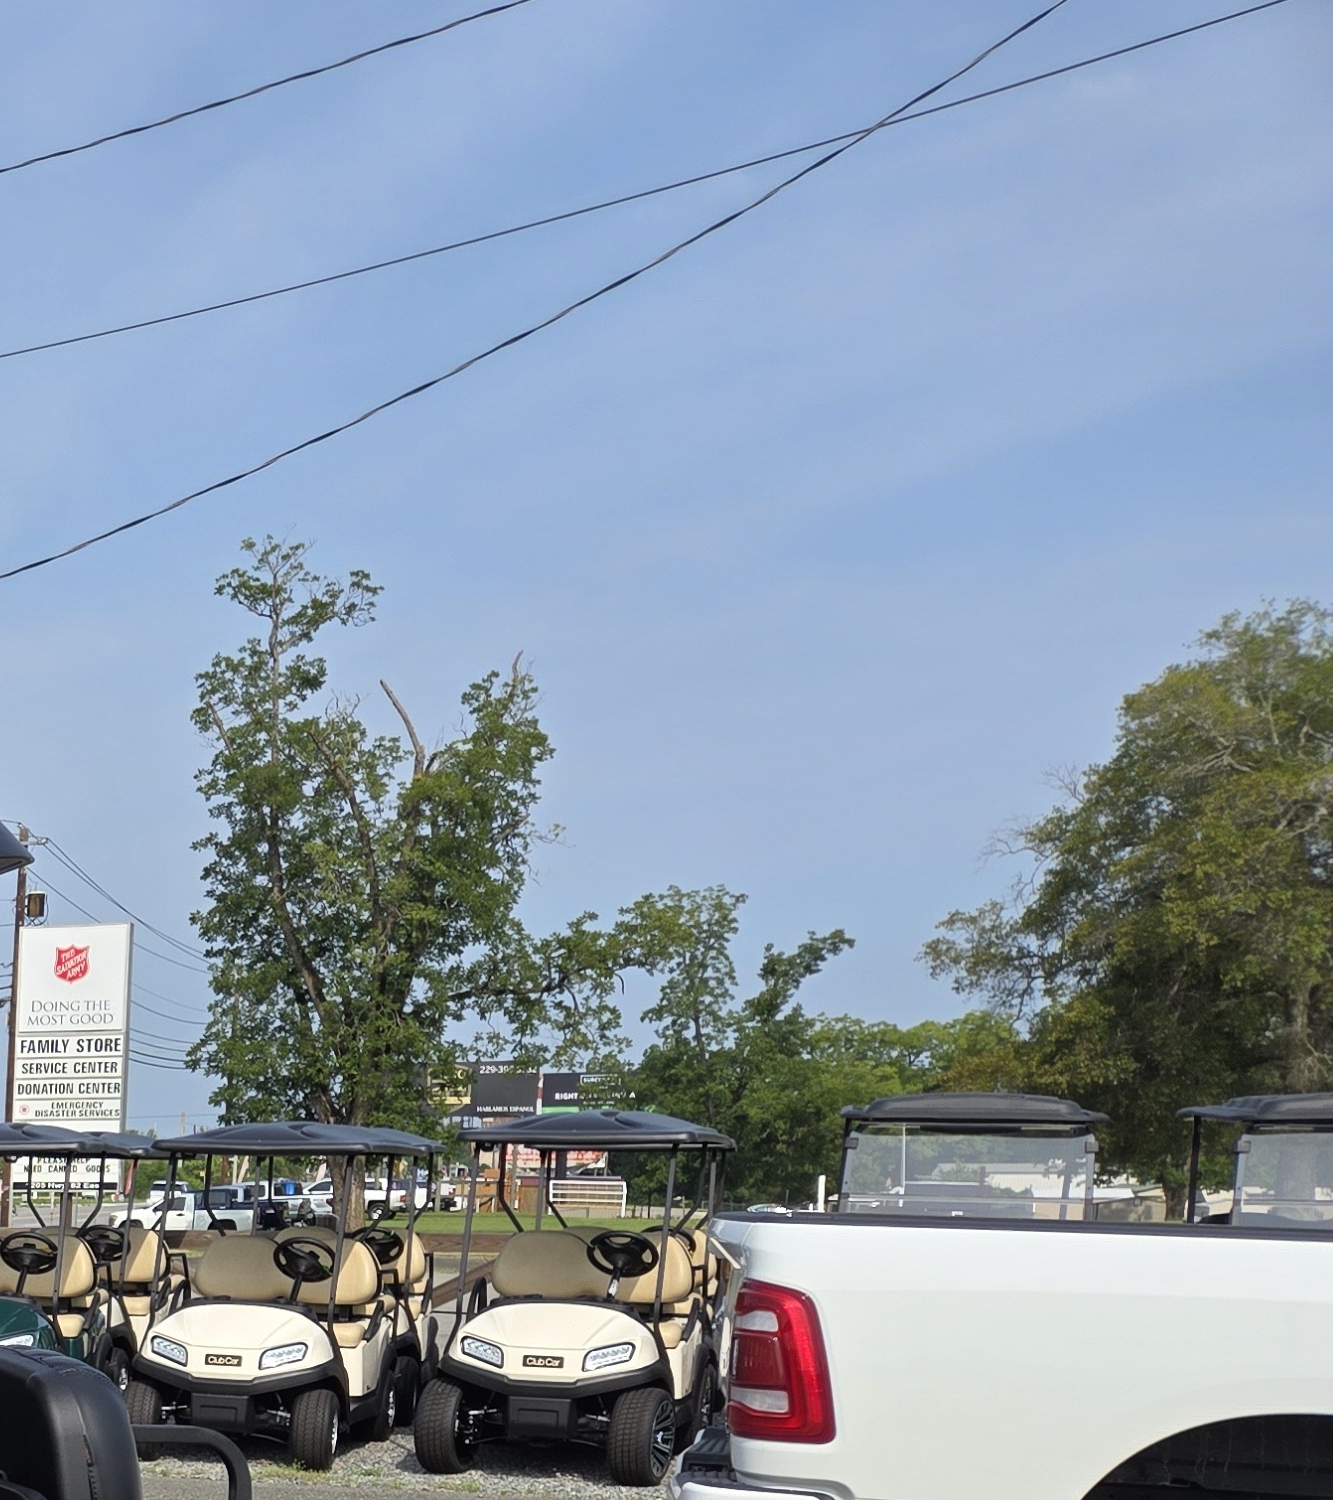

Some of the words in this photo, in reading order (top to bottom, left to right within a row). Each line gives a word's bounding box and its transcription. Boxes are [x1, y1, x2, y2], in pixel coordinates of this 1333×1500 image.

[31, 1000, 80, 1013] DOING
[83, 999, 111, 1011] THE
[27, 1014, 66, 1026] MOST
[69, 1013, 114, 1025] GOOD
[20, 1039, 70, 1054] FAMILY
[76, 1038, 121, 1053] STORE
[21, 1062, 68, 1075] SERVICE
[73, 1061, 118, 1074] CENTER
[17, 1083, 74, 1095] DONATION
[78, 1082, 121, 1095] CENTER
[554, 1092, 579, 1100] RIGHT
[51, 1101, 104, 1109] EMERGENCY
[34, 1109, 77, 1117] DISASTER
[78, 1109, 120, 1117] SERVICES
[23, 1165, 42, 1173] NED
